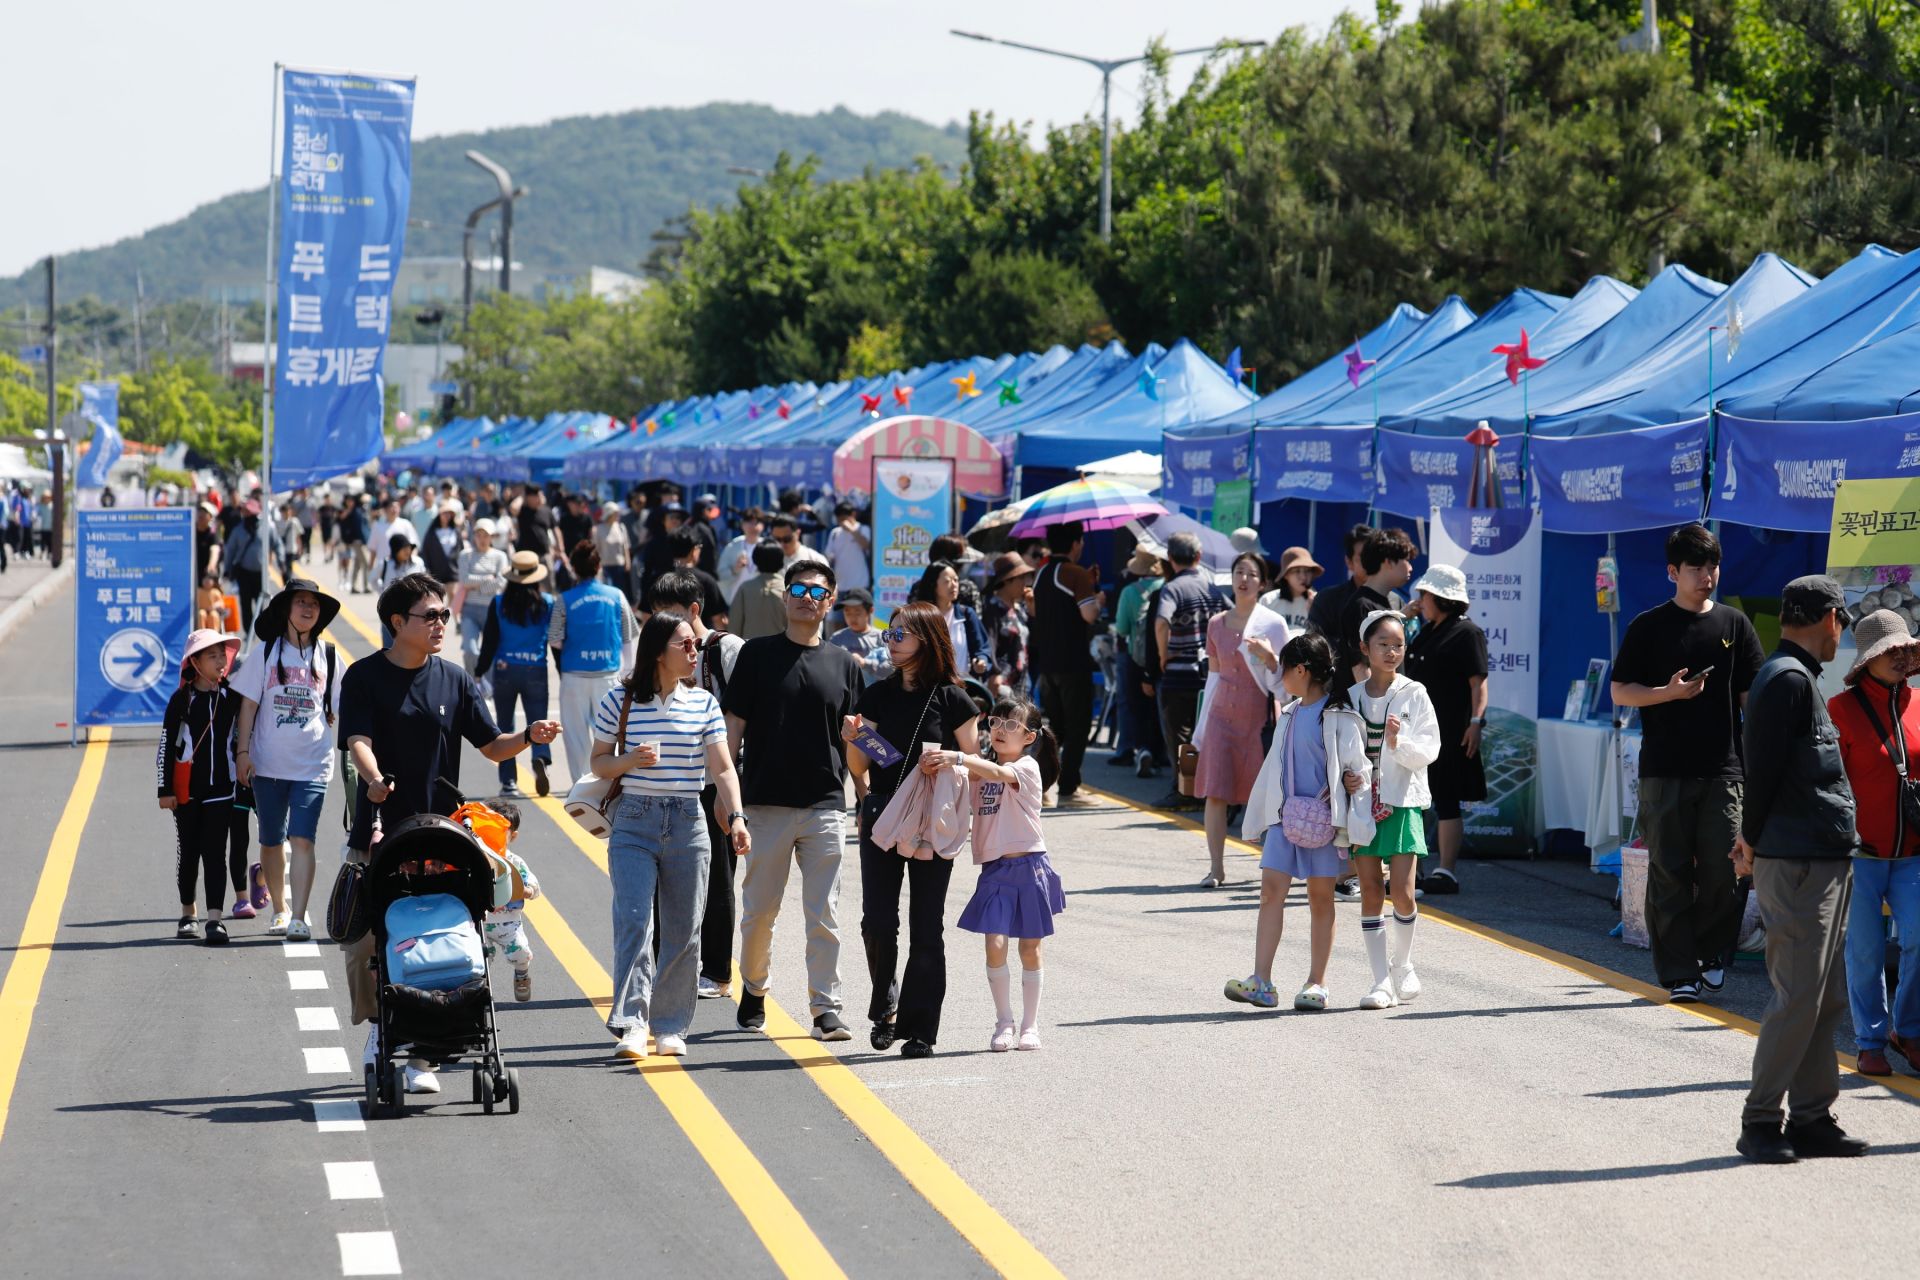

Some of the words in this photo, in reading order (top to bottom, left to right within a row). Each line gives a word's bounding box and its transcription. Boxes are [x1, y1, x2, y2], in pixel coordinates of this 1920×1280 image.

[285, 346, 380, 387] 휴게존
[1838, 509, 1920, 538] 꽃핀표고
[1477, 574, 1521, 585] 스마트하게
[97, 587, 172, 604] 푸드트럭
[1481, 590, 1521, 601] 매력있게
[106, 606, 162, 624] 휴게존
